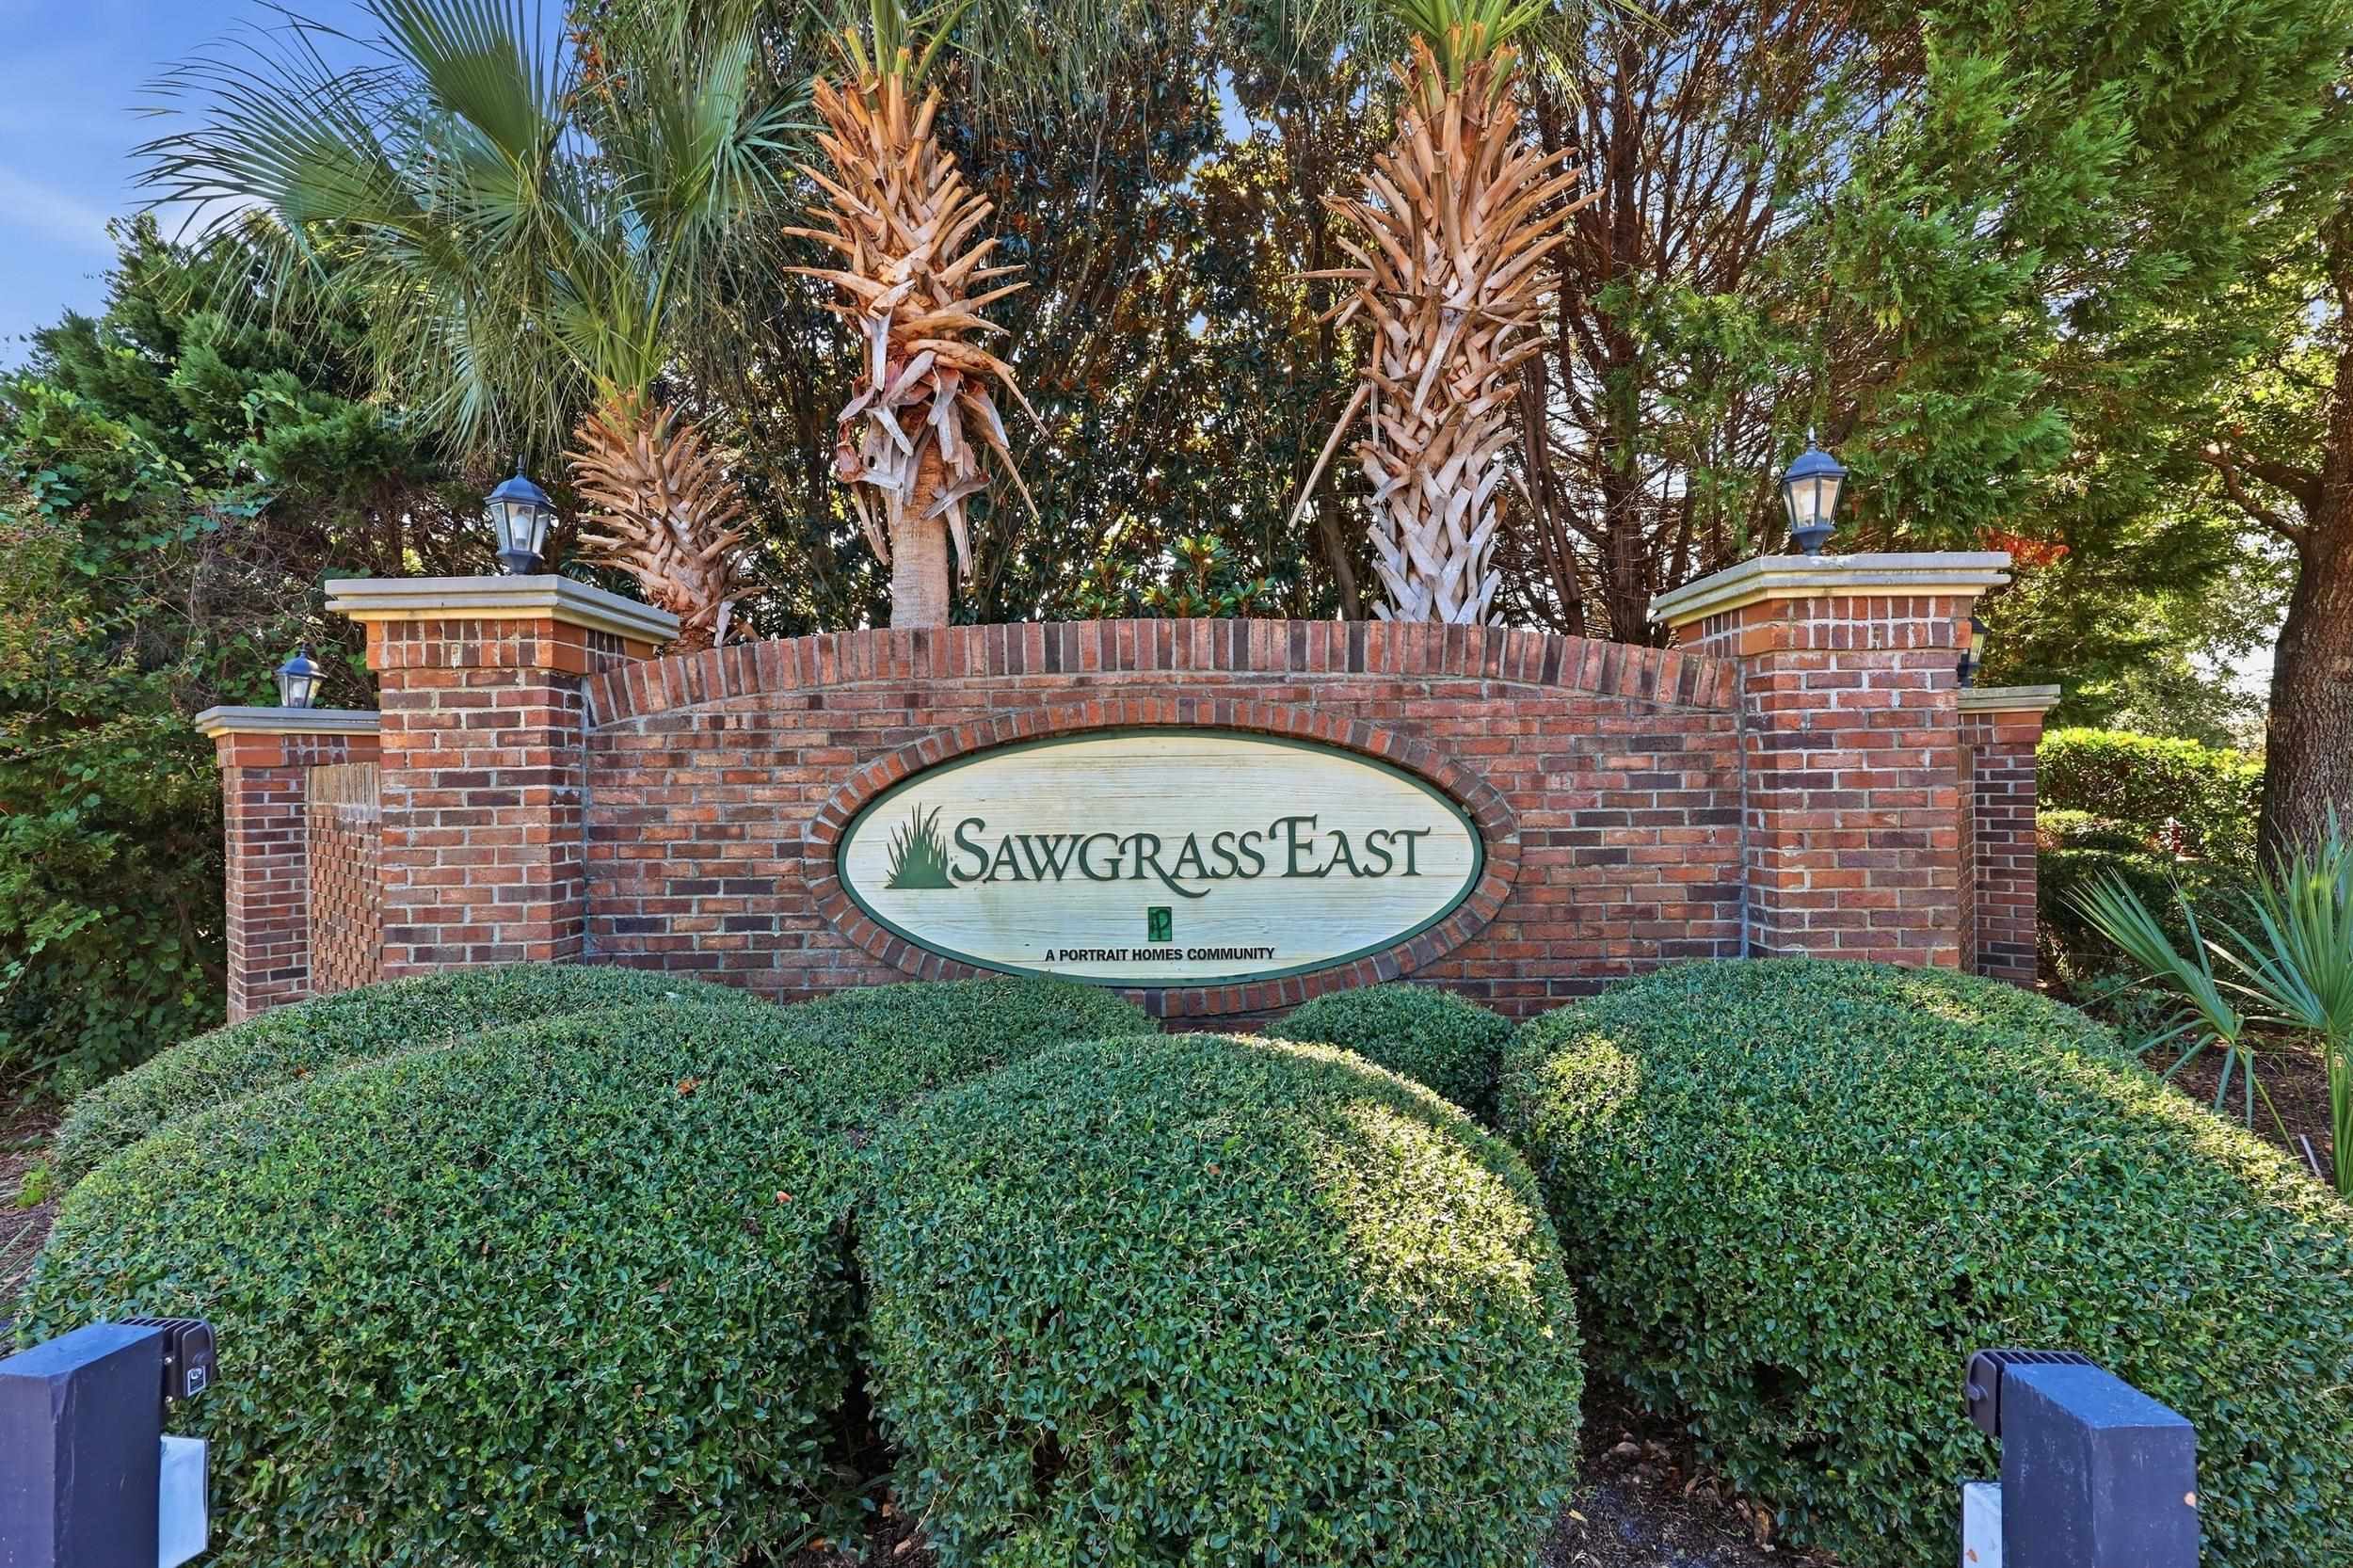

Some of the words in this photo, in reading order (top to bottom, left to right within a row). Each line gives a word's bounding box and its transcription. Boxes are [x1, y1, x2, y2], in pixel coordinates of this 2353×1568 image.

[952, 817, 1265, 897] SAWGRASS
[1269, 814, 1431, 877] EAST
[1045, 949, 1055, 961] A
[1059, 949, 1128, 961] PORTRAIT
[1132, 949, 1183, 961] HOMES
[1187, 948, 1275, 961] COMMUNITY
